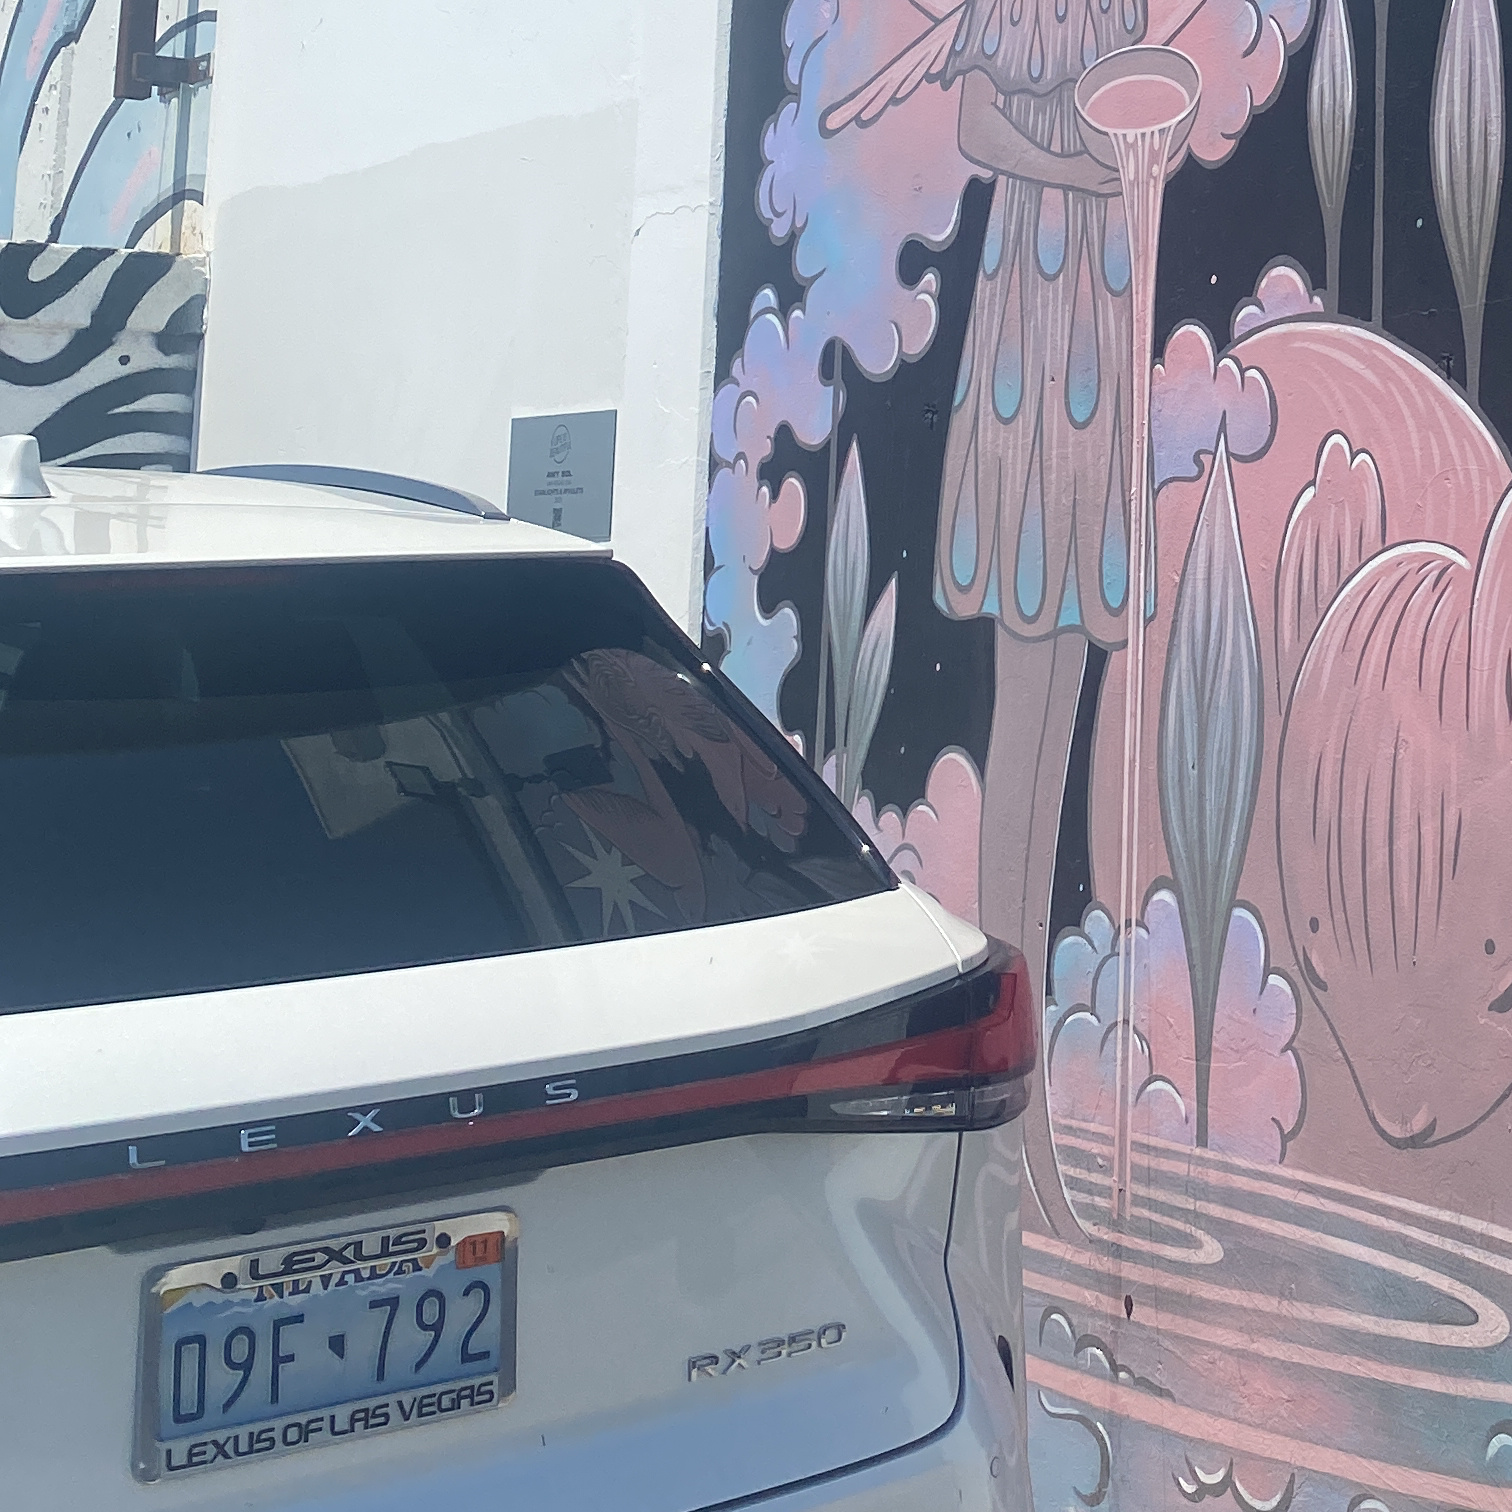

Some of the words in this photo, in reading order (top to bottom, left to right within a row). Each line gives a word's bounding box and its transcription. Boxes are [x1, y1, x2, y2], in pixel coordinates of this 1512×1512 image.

[128, 1079, 579, 1170] LEXUS
[249, 1228, 429, 1281] LEXUS
[368, 1279, 492, 1383] 792
[165, 1427, 277, 1472] LEXUS
[282, 1416, 326, 1447] OF
[328, 1402, 391, 1436] LAS
[398, 1380, 497, 1422] VEGAS
